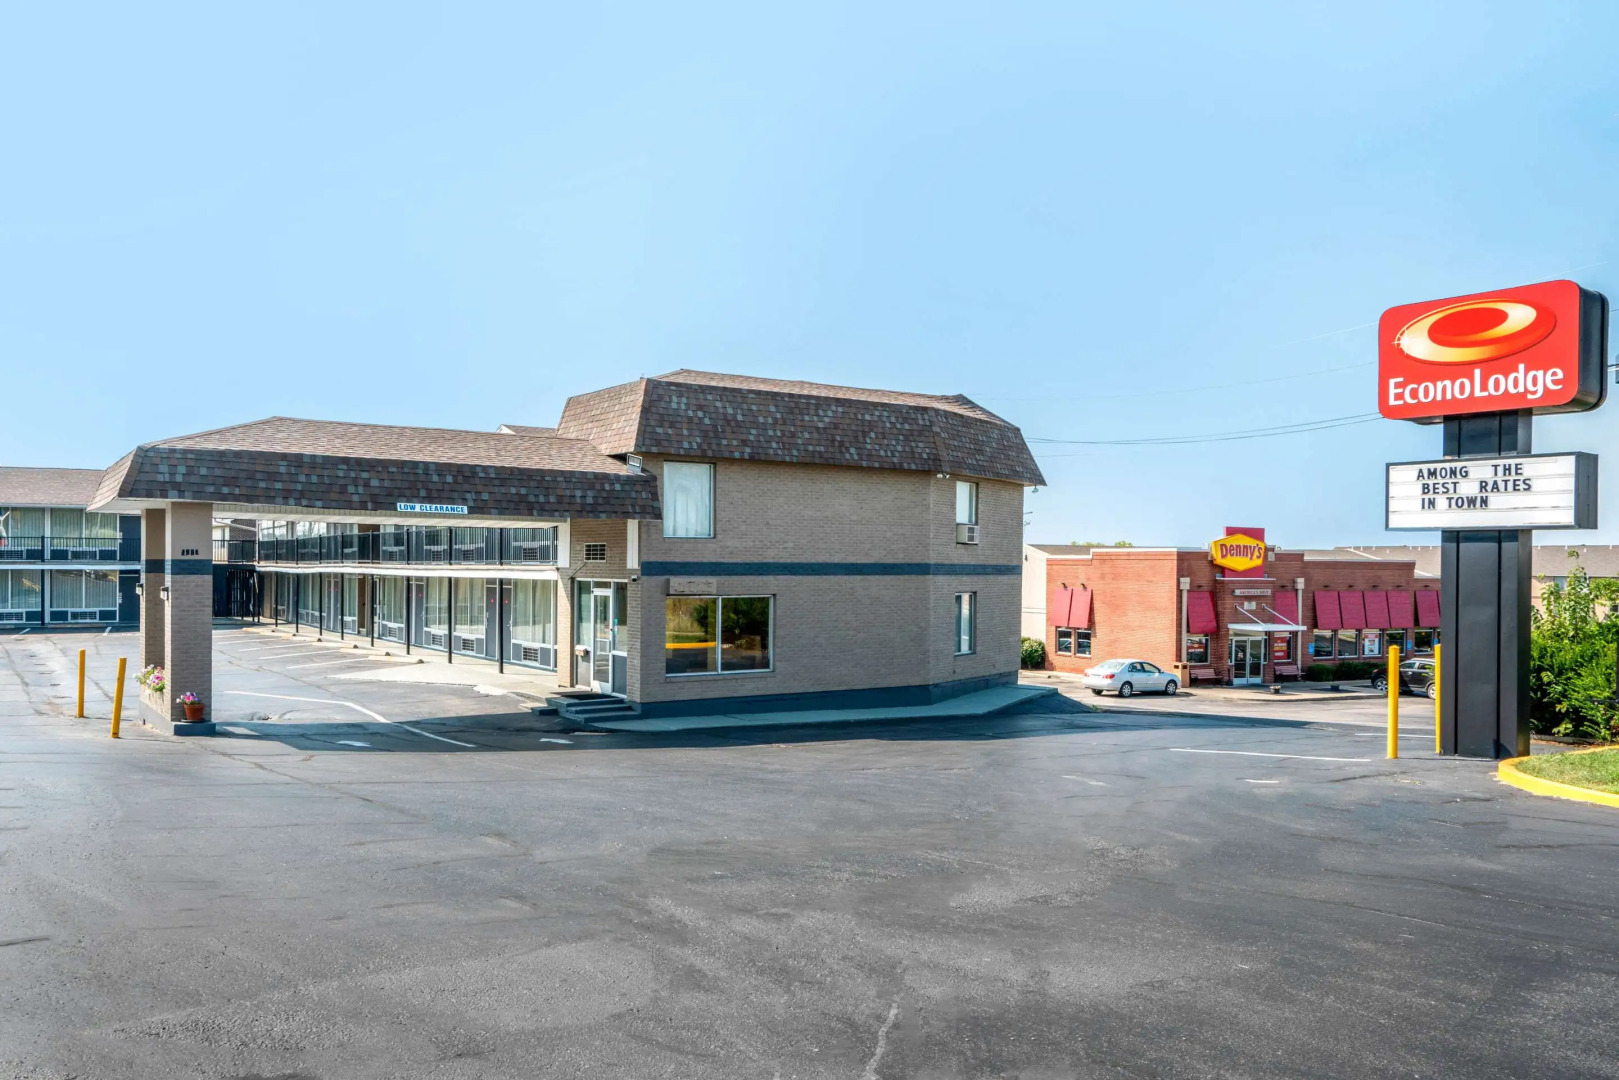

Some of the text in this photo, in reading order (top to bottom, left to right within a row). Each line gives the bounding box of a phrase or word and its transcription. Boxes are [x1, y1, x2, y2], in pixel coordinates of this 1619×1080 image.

[1417, 463, 1523, 480] AMONG THE
[1422, 478, 1532, 495] BEST RATES
[399, 503, 465, 513] LOW CLEARANCE
[1421, 496, 1489, 510] IN TOWN
[1219, 543, 1263, 561] Denny's
